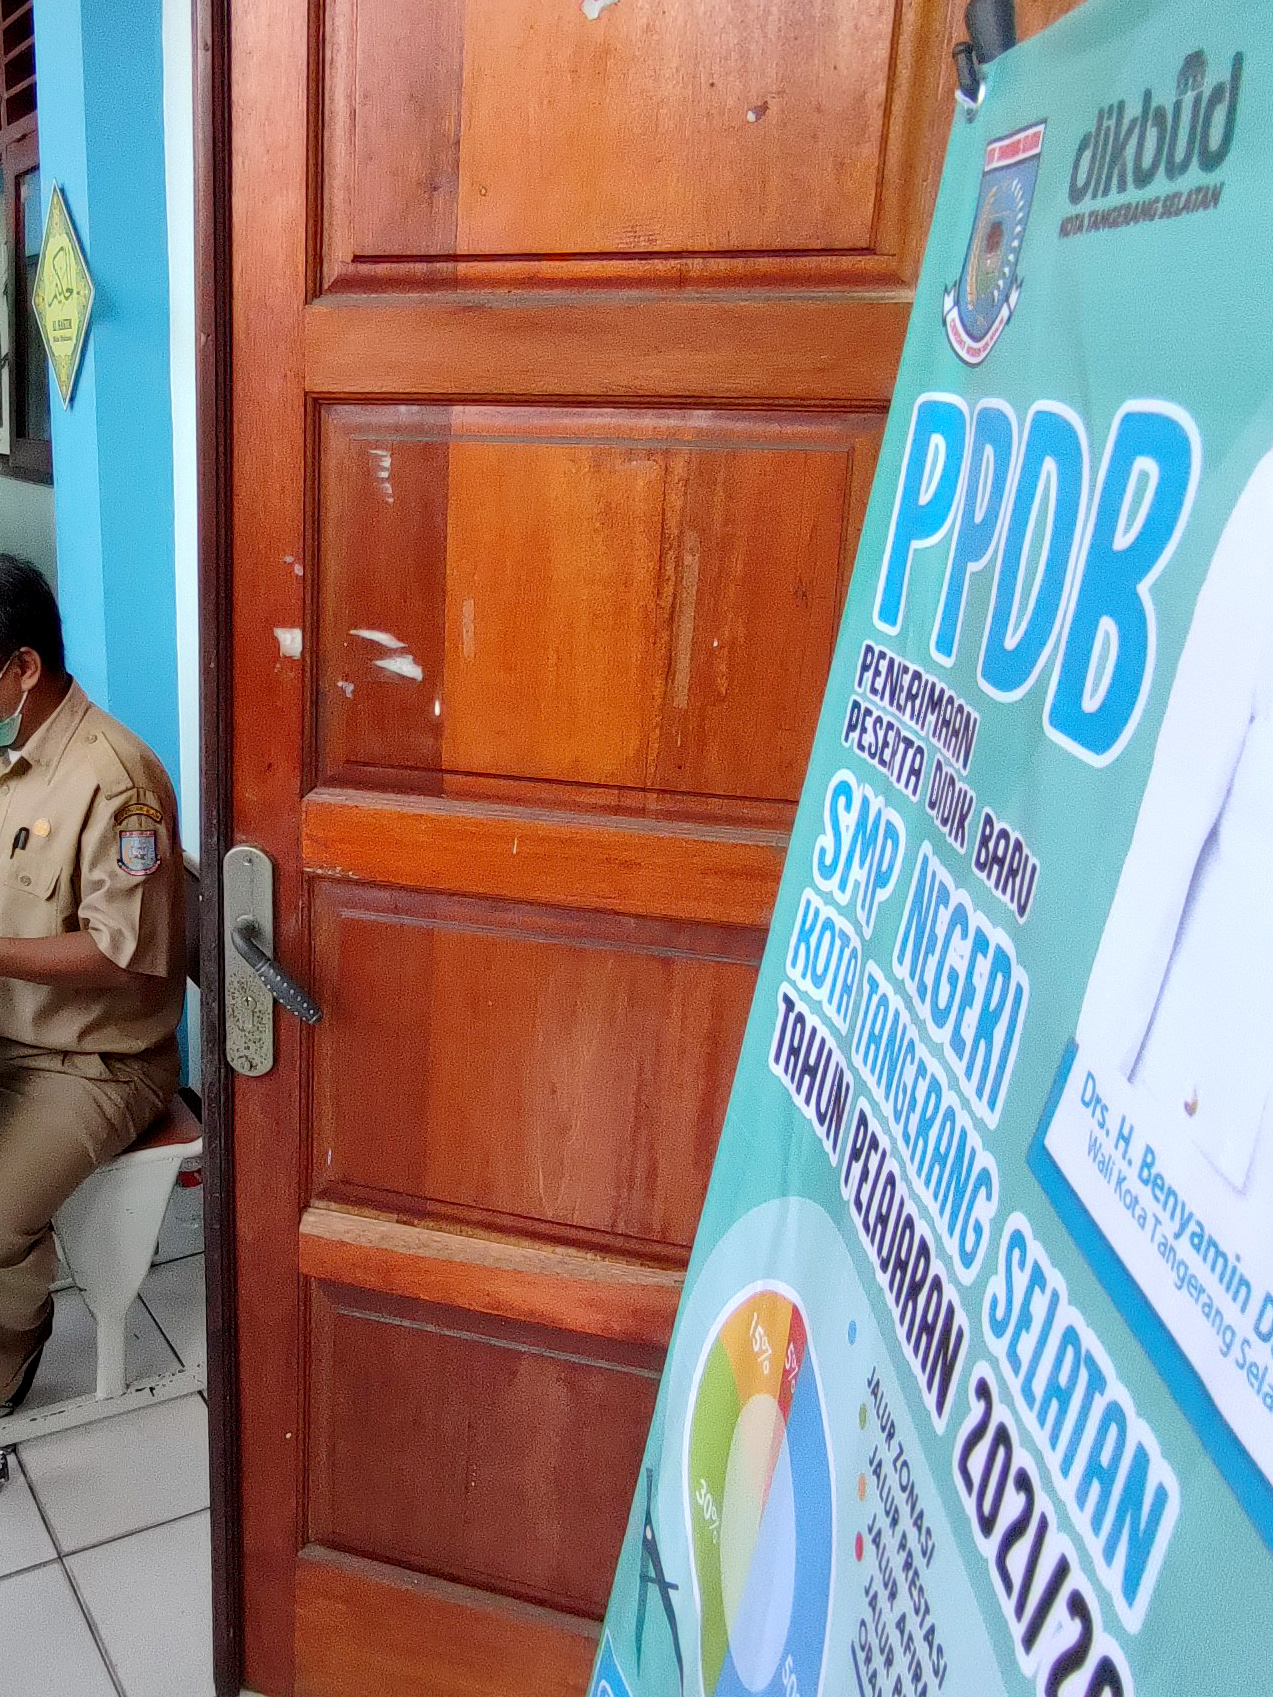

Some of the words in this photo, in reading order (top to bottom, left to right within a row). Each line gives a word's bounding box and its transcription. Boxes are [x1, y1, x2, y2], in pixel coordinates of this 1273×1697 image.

[1059, 212, 1086, 238] KOTA
[1086, 196, 1161, 232] TANGERANG
[1159, 182, 1224, 220] SELATAN
[875, 394, 1201, 766] PPDB
[844, 698, 926, 798] PESERTA
[928, 758, 974, 849] DIDIK
[974, 812, 1038, 919] BARU
[858, 642, 978, 771] PENERIMAAN
[817, 779, 901, 932] SMP
[897, 852, 1025, 1115] NEGERI
[773, 991, 851, 1155] TAHUN
[844, 1107, 965, 1419] PELAJARAN
[790, 897, 859, 1025] KOTA
[855, 971, 993, 1270] TANGERANG
[988, 1228, 1169, 1609] SELATAN
[1080, 1070, 1110, 1138] Drs.
[1114, 1114, 1134, 1167] H.
[1138, 1143, 1253, 1315] Benyamin
[1087, 1130, 1114, 1185] Wali
[1114, 1168, 1148, 1232] Kota
[1148, 1212, 1237, 1359] Tangerang
[749, 1311, 773, 1375] 15%
[784, 1341, 799, 1393] 5%
[695, 1478, 720, 1545] 30%
[866, 1365, 896, 1453] JALUR
[892, 1440, 936, 1571] ZONASI
[866, 1511, 898, 1613] JALUR
[868, 1443, 900, 1539] JALUR
[896, 1528, 948, 1692] PRESTASI
[863, 1573, 895, 1681] JALUR
